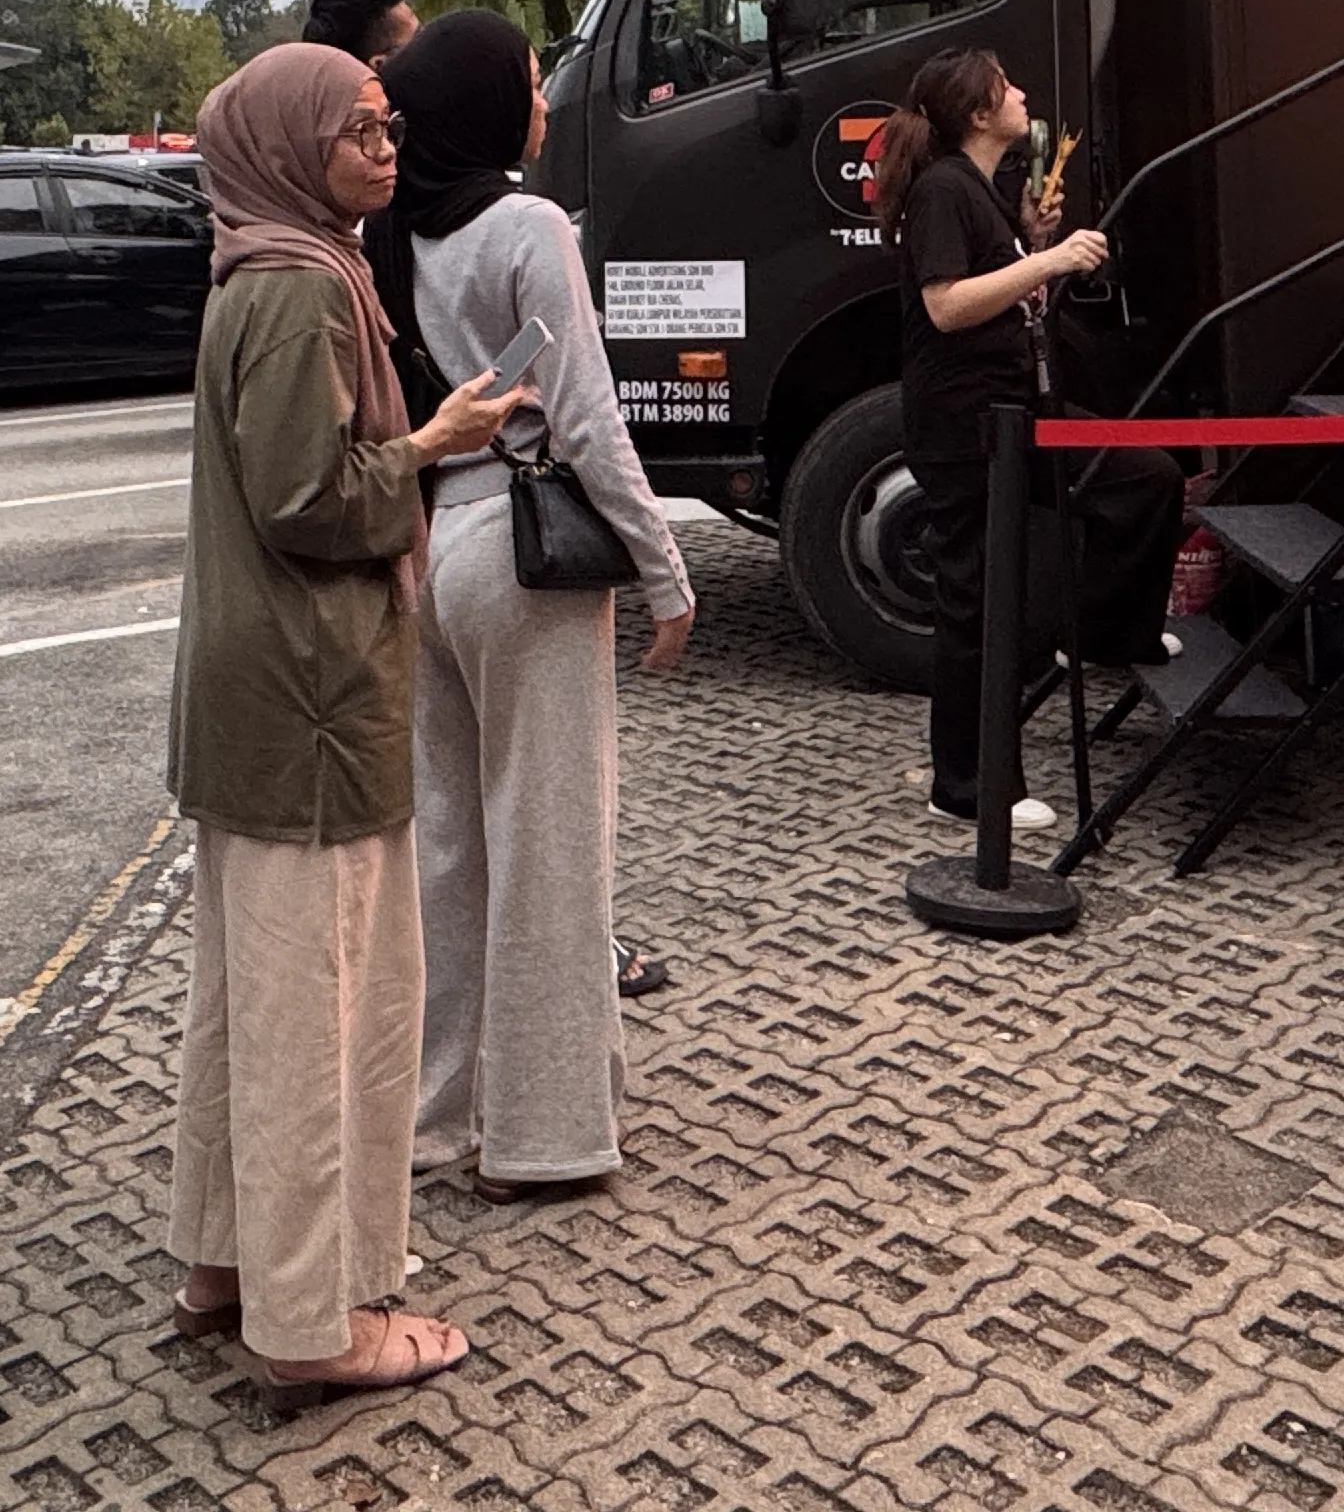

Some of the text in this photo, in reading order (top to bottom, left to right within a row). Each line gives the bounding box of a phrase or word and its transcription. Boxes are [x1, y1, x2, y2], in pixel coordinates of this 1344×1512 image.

[618, 380, 731, 400] BDM 7500 KG
[619, 404, 731, 423] BTM 3890 KG
